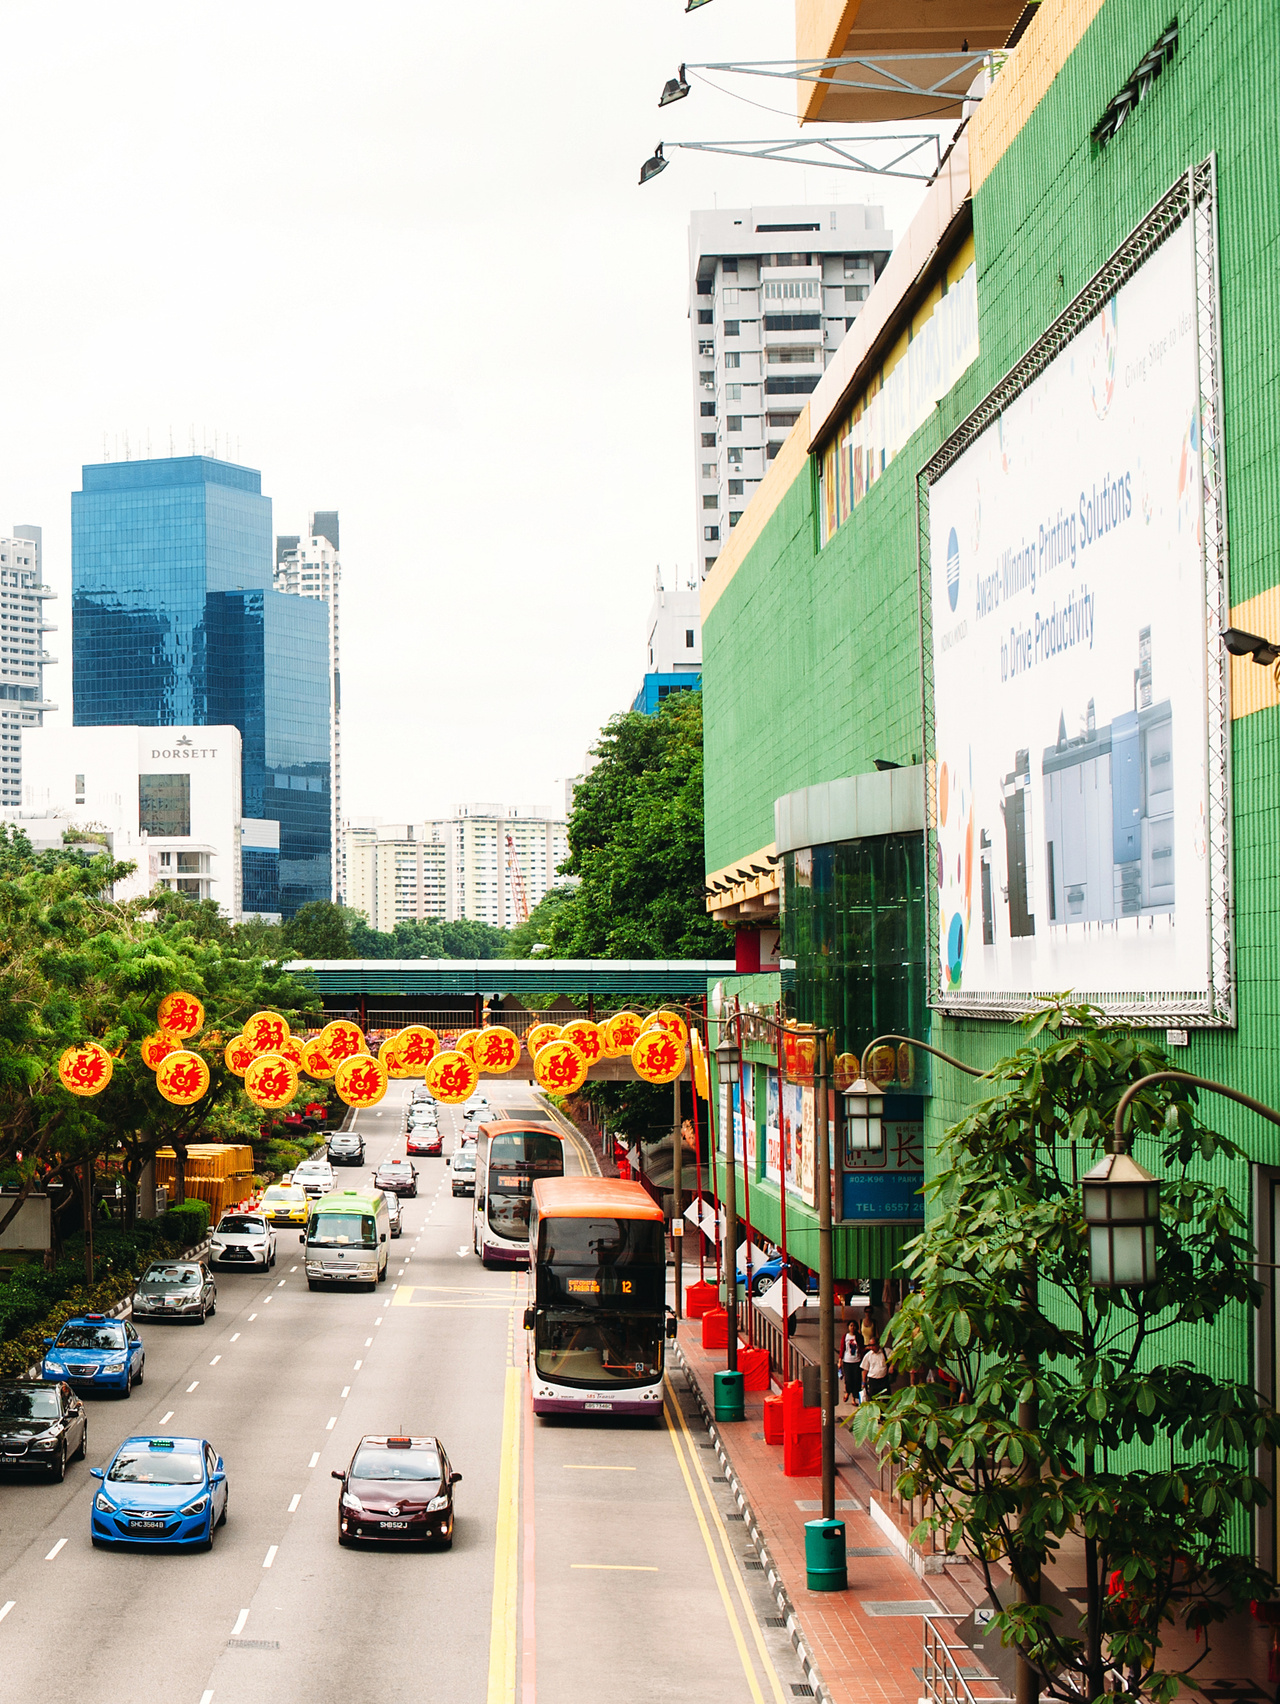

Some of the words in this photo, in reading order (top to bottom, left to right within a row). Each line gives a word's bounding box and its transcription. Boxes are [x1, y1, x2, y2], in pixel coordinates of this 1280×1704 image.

[976, 537, 1036, 622] Award-Winning
[1039, 507, 1076, 577] Printing
[1079, 471, 1132, 549] Solutions
[1001, 635, 1008, 683] to
[1010, 621, 1032, 678] Drive
[1035, 583, 1094, 664] Productivity
[151, 749, 218, 759] DORSETT
[890, 1132, 924, 1168] 长
[856, 1203, 876, 1212] TEL
[885, 1203, 910, 1211] 6557
[621, 1280, 632, 1293] 12
